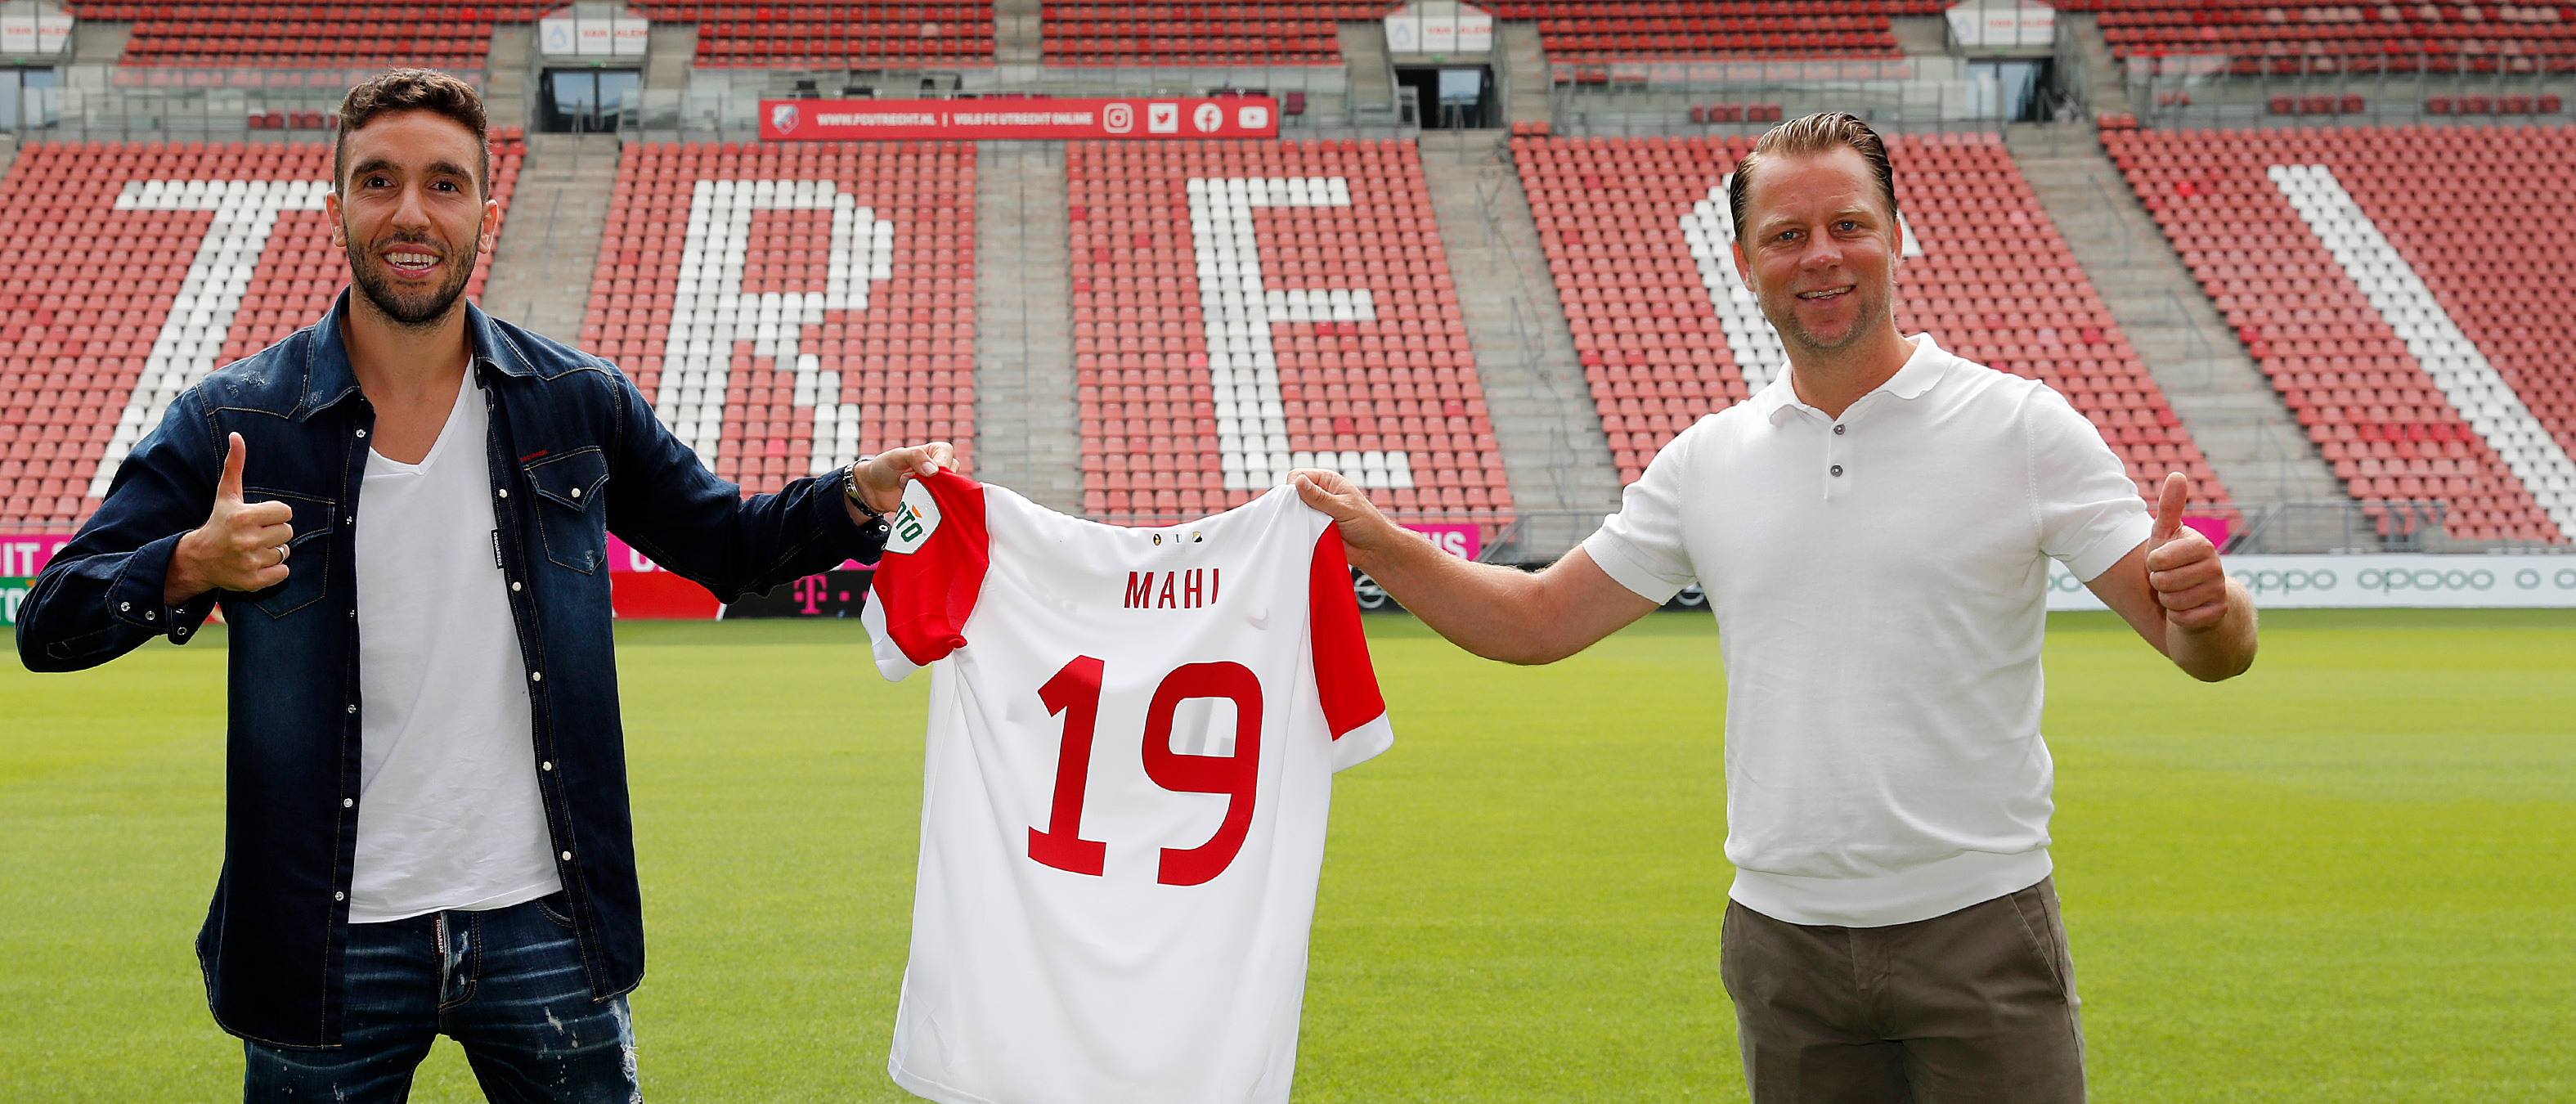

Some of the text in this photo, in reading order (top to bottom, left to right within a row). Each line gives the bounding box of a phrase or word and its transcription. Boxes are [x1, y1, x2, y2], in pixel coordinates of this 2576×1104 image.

[1052, 111, 1094, 126] ONLINE
[0, 542, 40, 577] IT
[493, 532, 503, 567] DSQUARED2
[1124, 568, 1219, 609] MAHI
[1028, 653, 1264, 887] 19
[436, 918, 444, 954] DSQUARED2
